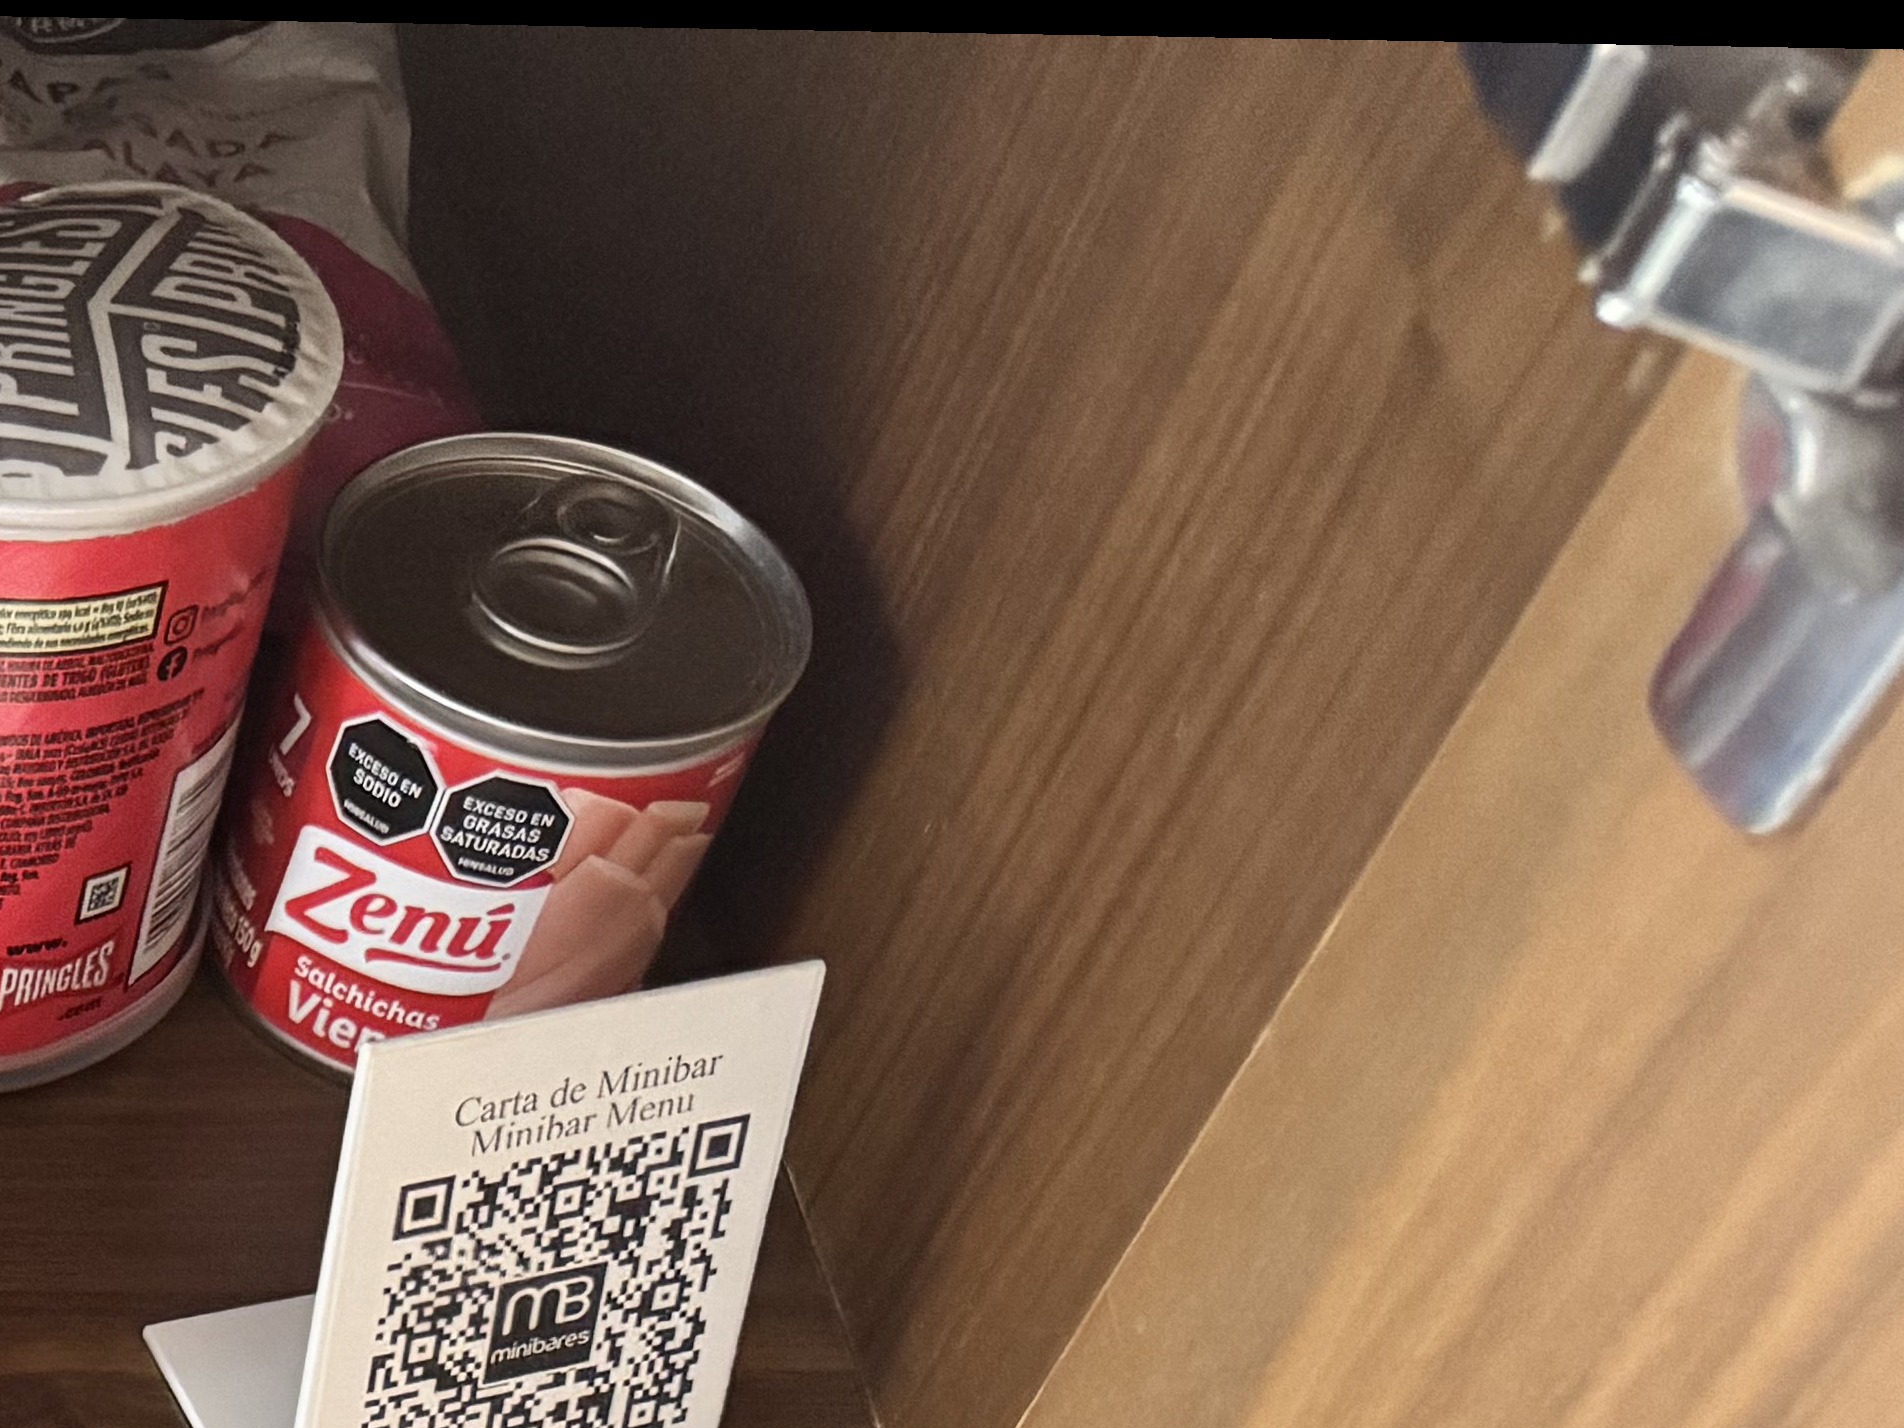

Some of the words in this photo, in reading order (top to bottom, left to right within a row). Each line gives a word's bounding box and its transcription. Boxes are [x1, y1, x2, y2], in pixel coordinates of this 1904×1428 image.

[348, 741, 398, 786] EXCESO
[400, 775, 423, 800] EN
[353, 767, 401, 809] SODIO
[462, 795, 527, 826] EXCESO
[530, 809, 556, 829] EN
[462, 815, 542, 845] GRASAS
[440, 825, 550, 864] SATURADAS
[285, 846, 516, 960] Zenú
[294, 954, 441, 1031] Salchichas
[455, 1091, 541, 1130] Carta
[550, 1075, 589, 1109] de
[597, 1050, 725, 1100] Minibar
[472, 1108, 597, 1158] Minibar
[606, 1091, 696, 1130] Menu
[491, 1327, 591, 1366] minibares
